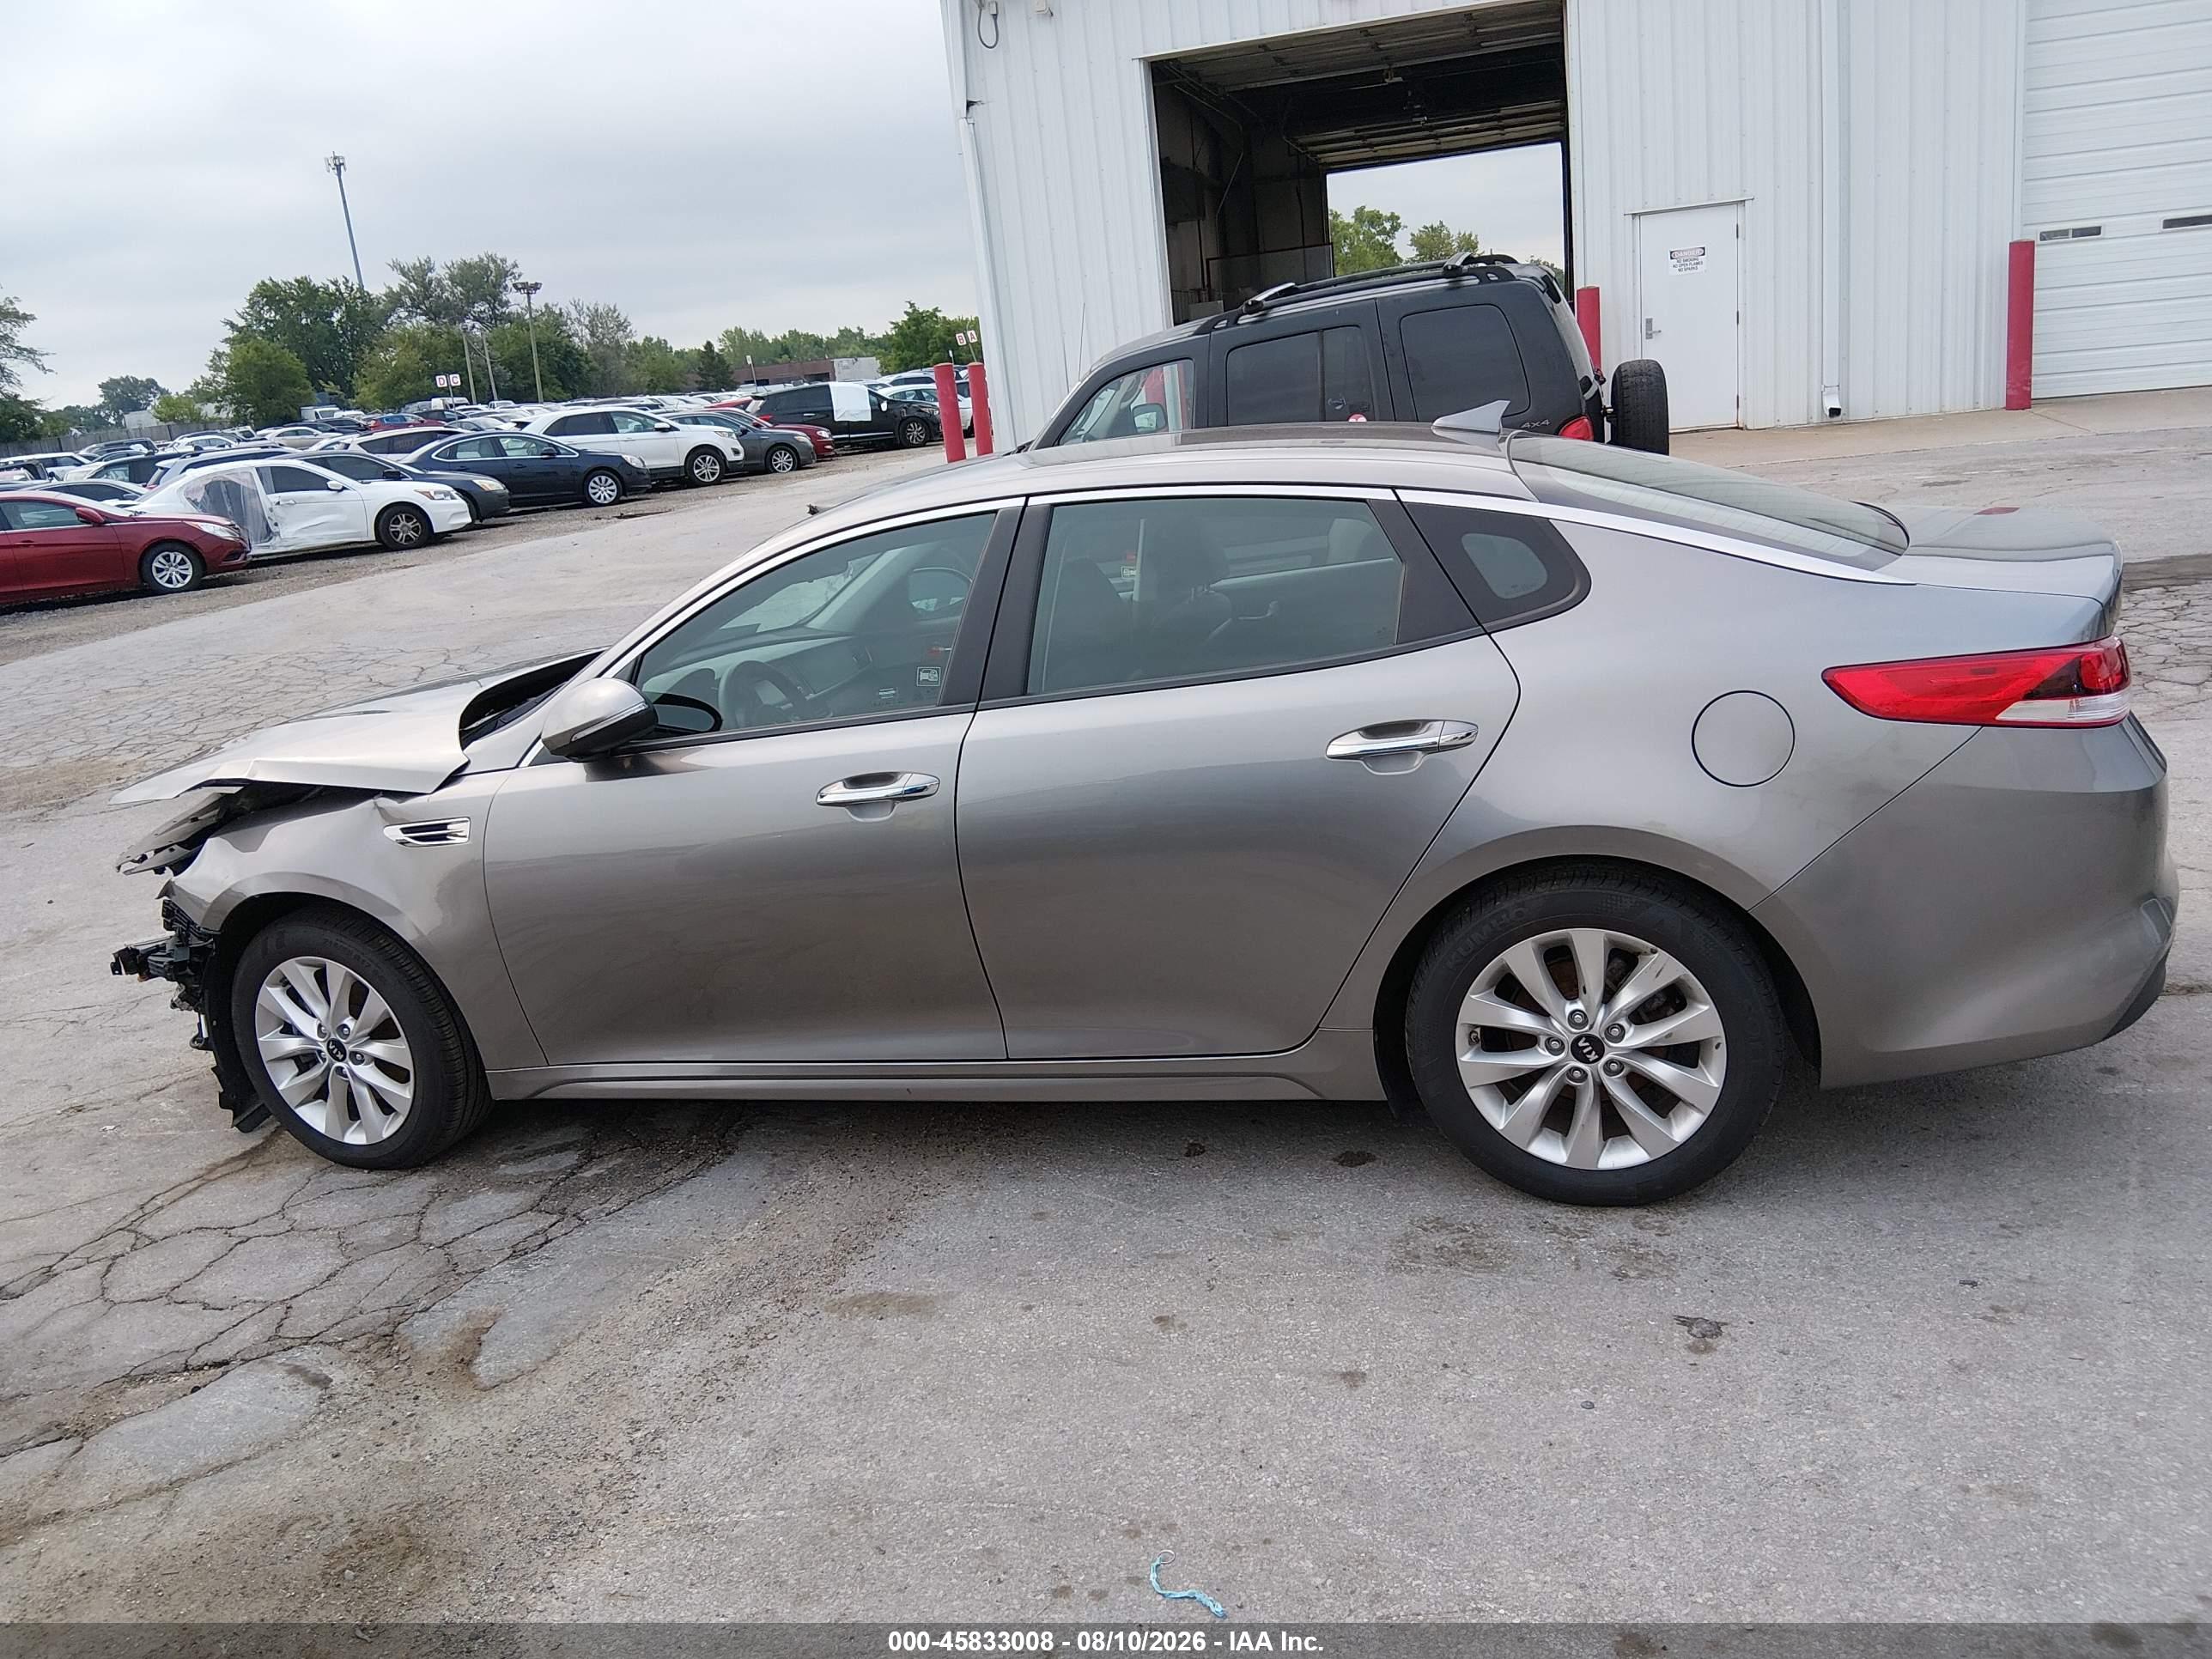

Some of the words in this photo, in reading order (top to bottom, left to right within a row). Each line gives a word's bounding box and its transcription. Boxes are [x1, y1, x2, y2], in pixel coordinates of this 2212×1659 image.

[957, 335, 965, 344] B
[969, 331, 976, 342] A
[439, 377, 446, 386] D
[452, 375, 459, 385] C
[329, 1041, 344, 1060] KIA
[1577, 1036, 1599, 1062] KIA
